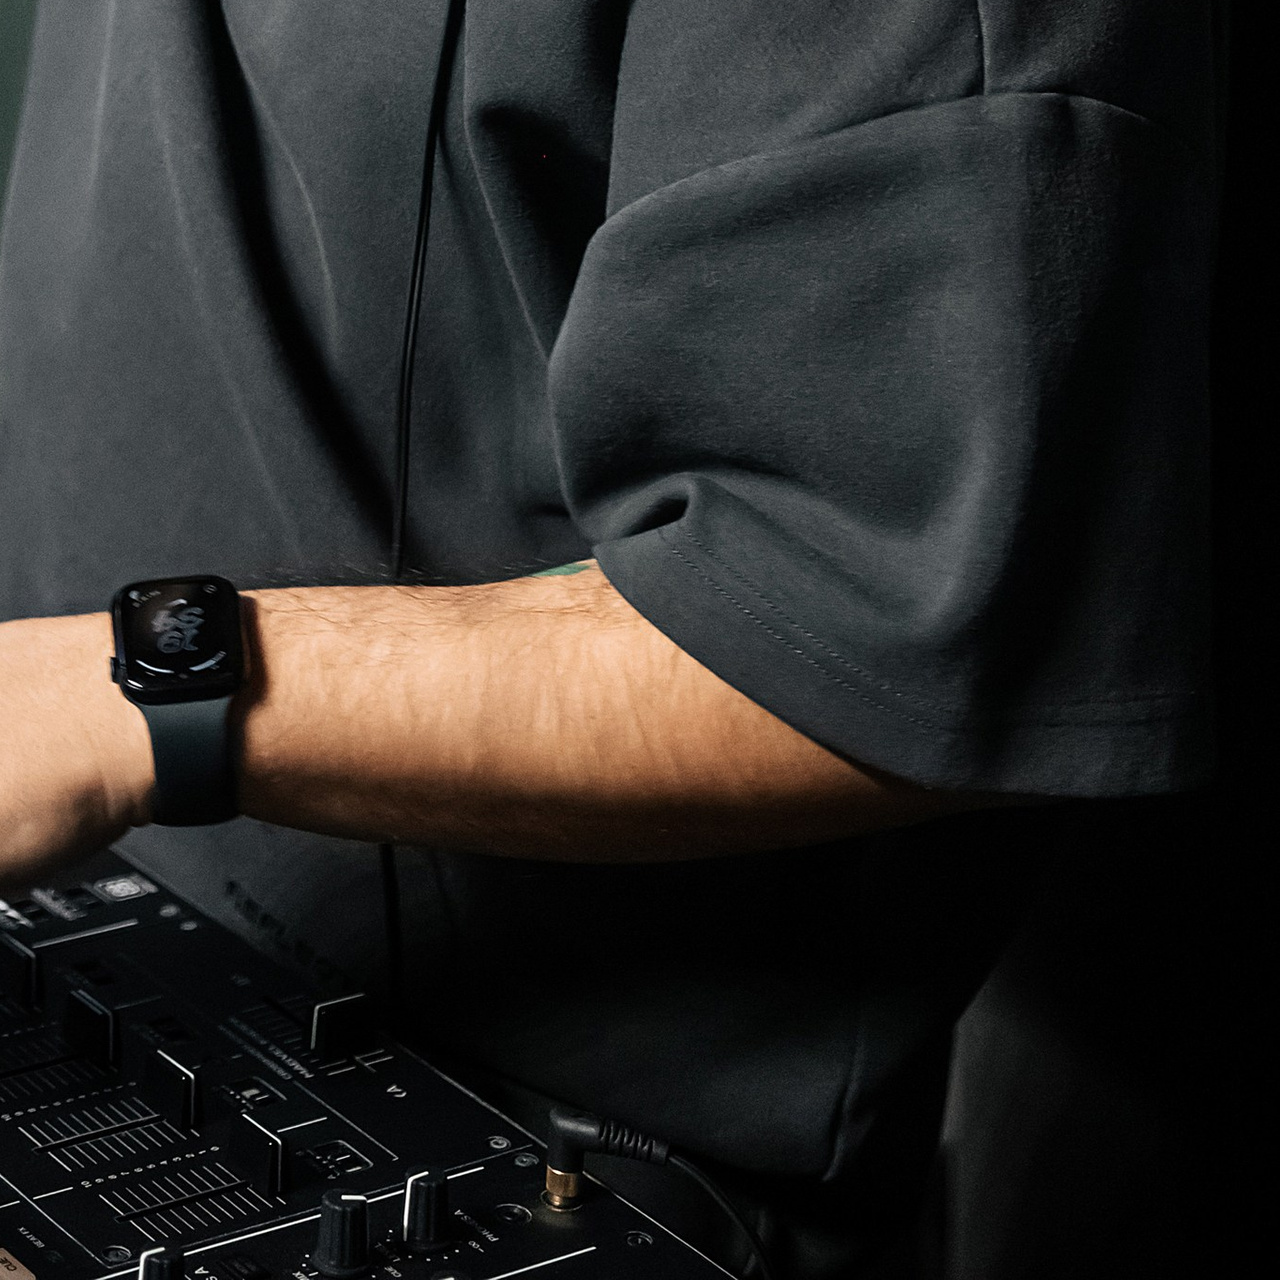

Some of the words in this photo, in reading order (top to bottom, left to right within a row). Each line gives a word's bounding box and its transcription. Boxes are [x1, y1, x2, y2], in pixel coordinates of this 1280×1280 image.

[18, 1227, 29, 1235] FX
[26, 1234, 45, 1248] BEAT
[384, 1266, 402, 1278] CUE
